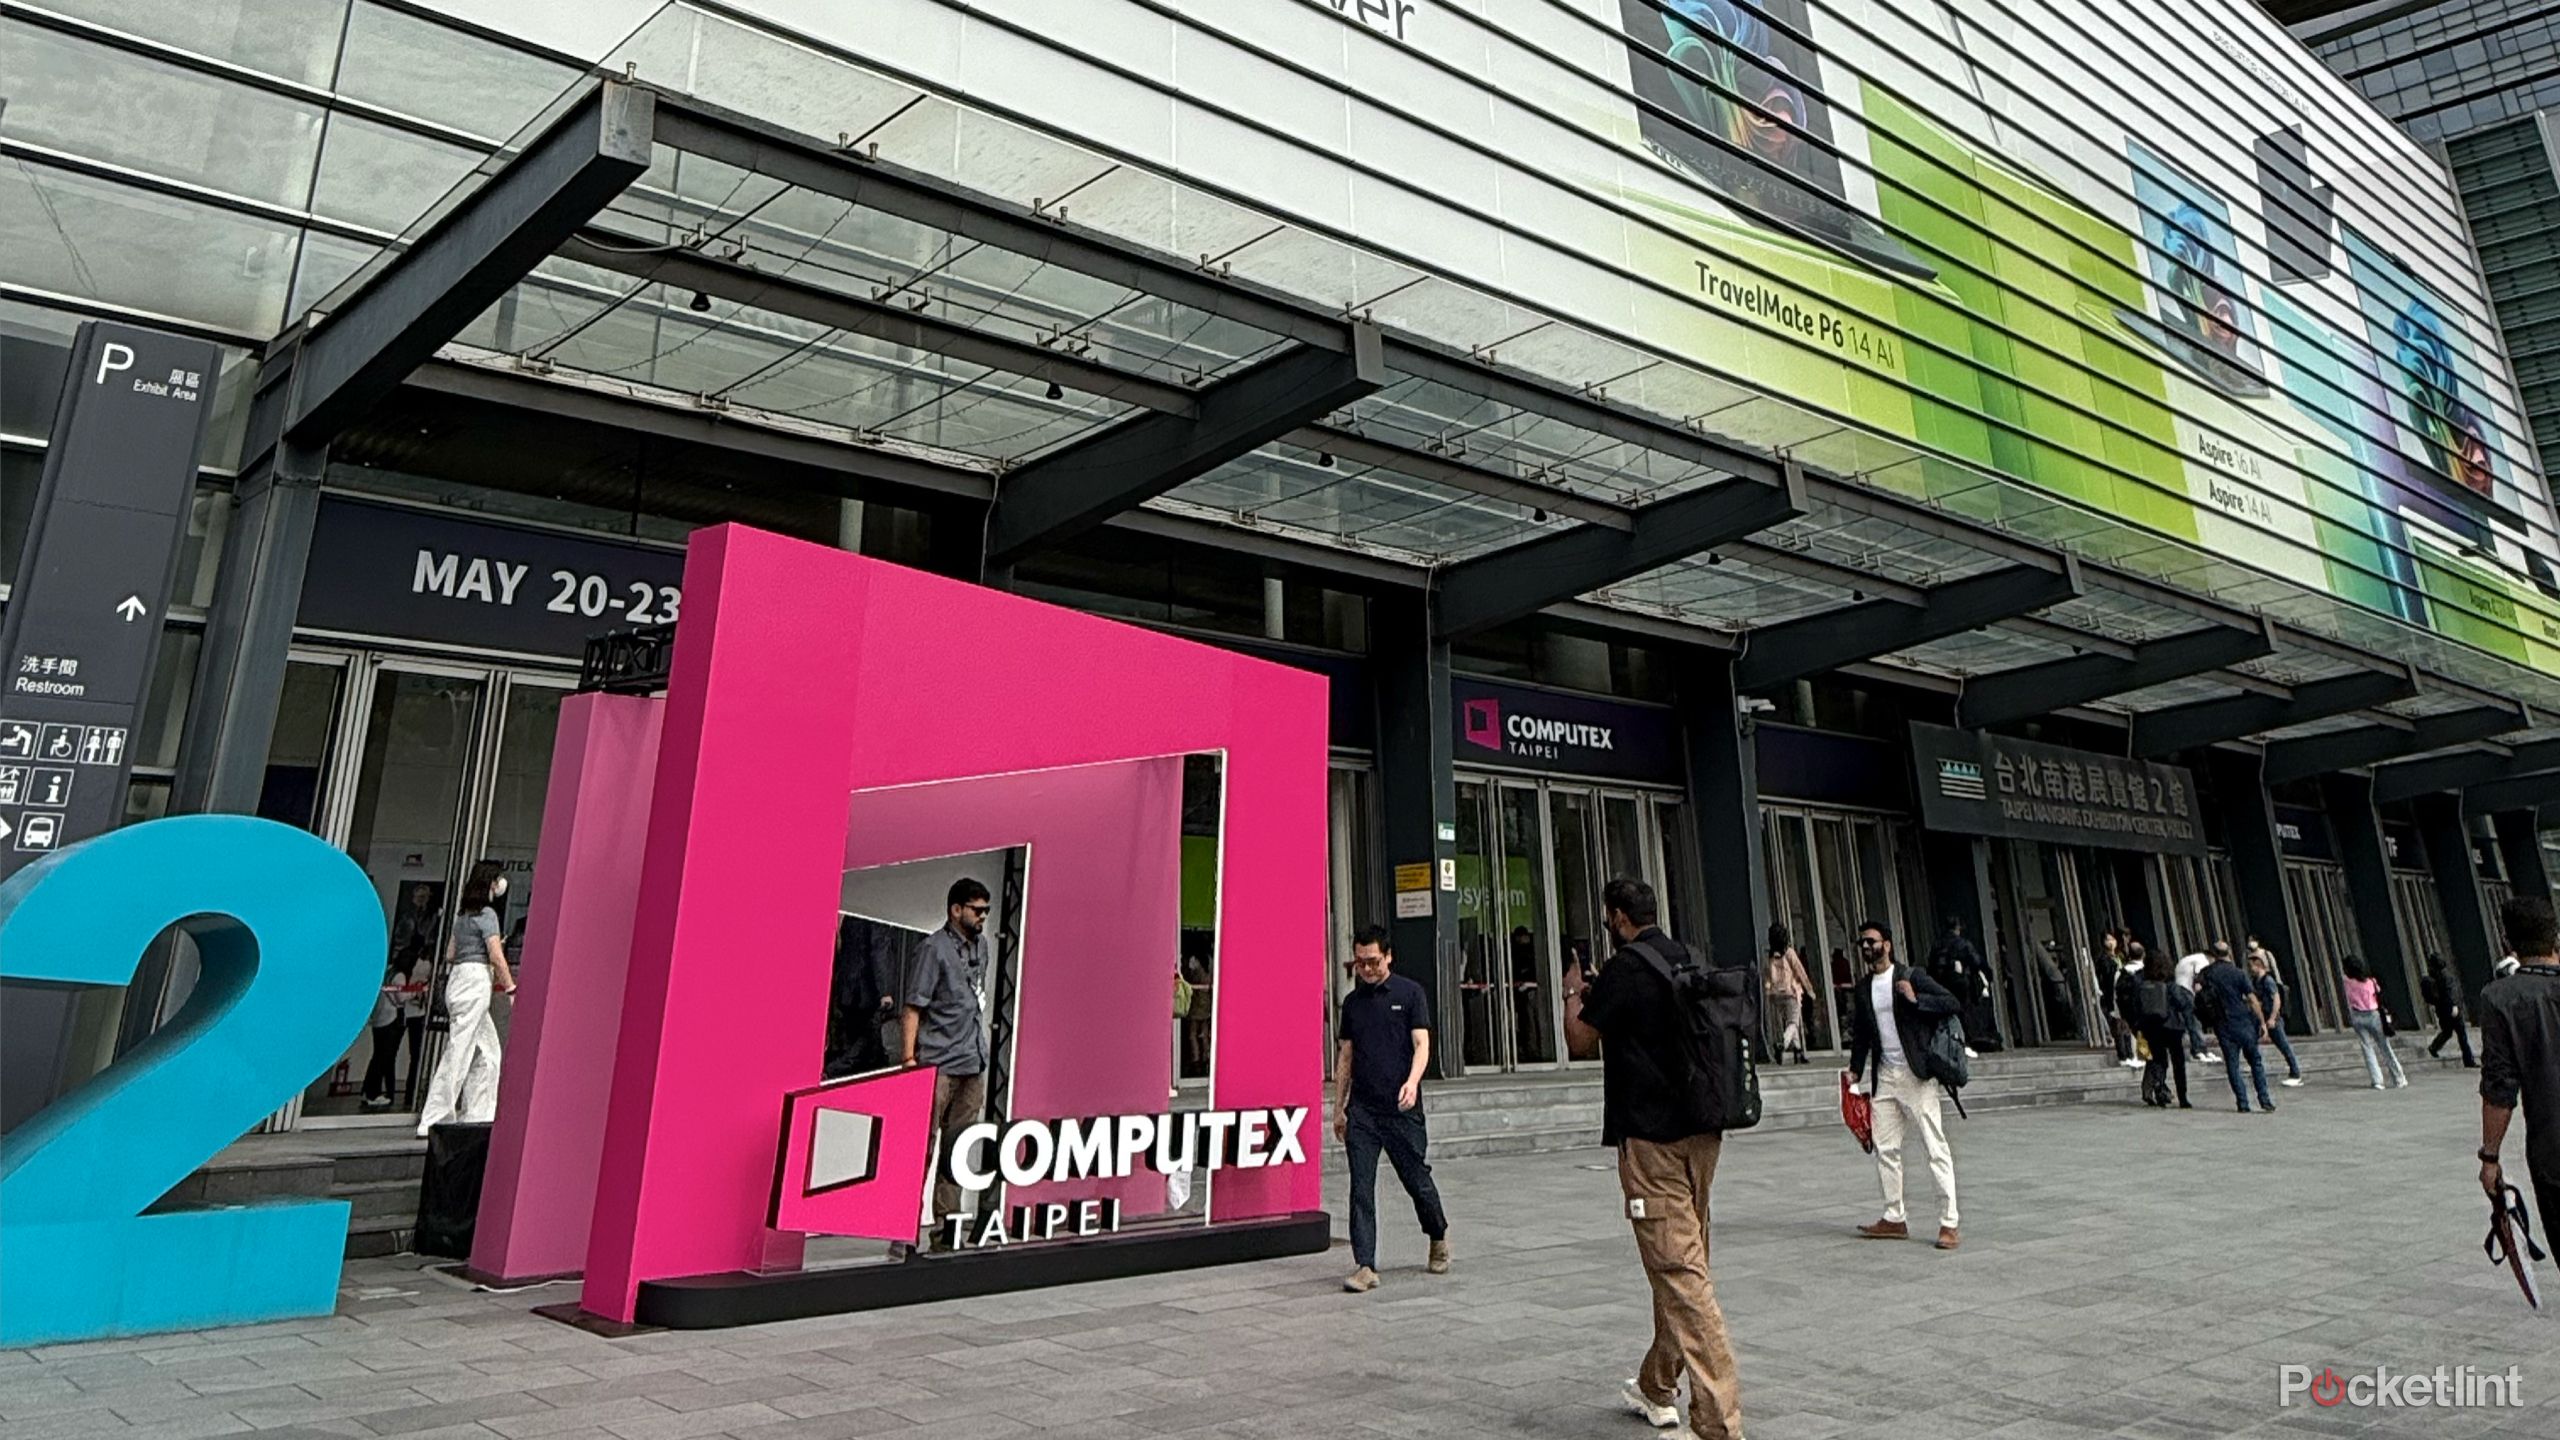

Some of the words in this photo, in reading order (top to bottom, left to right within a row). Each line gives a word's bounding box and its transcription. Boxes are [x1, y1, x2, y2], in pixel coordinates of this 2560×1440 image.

[1695, 261, 1814, 336] TravelMate
[1819, 313, 1844, 348] P6
[1848, 326, 1871, 360] 14
[1877, 338, 1895, 369] AI
[96, 342, 134, 385] P
[132, 378, 168, 397] Exhibit
[172, 387, 198, 401] Area
[2198, 433, 2235, 468] Aspire
[2208, 479, 2245, 514] Aspire
[412, 550, 529, 605] MAY
[546, 570, 683, 625] 20-23
[20, 655, 78, 676] 洗手間
[15, 676, 85, 696] Restroom
[1507, 714, 1614, 750] COMPUTEX
[1509, 741, 1559, 760] TAIPEI
[2001, 798, 2033, 822] TAIPEI
[951, 1107, 1309, 1191] COMPUTEX
[946, 1198, 1121, 1250] TAIPEI
